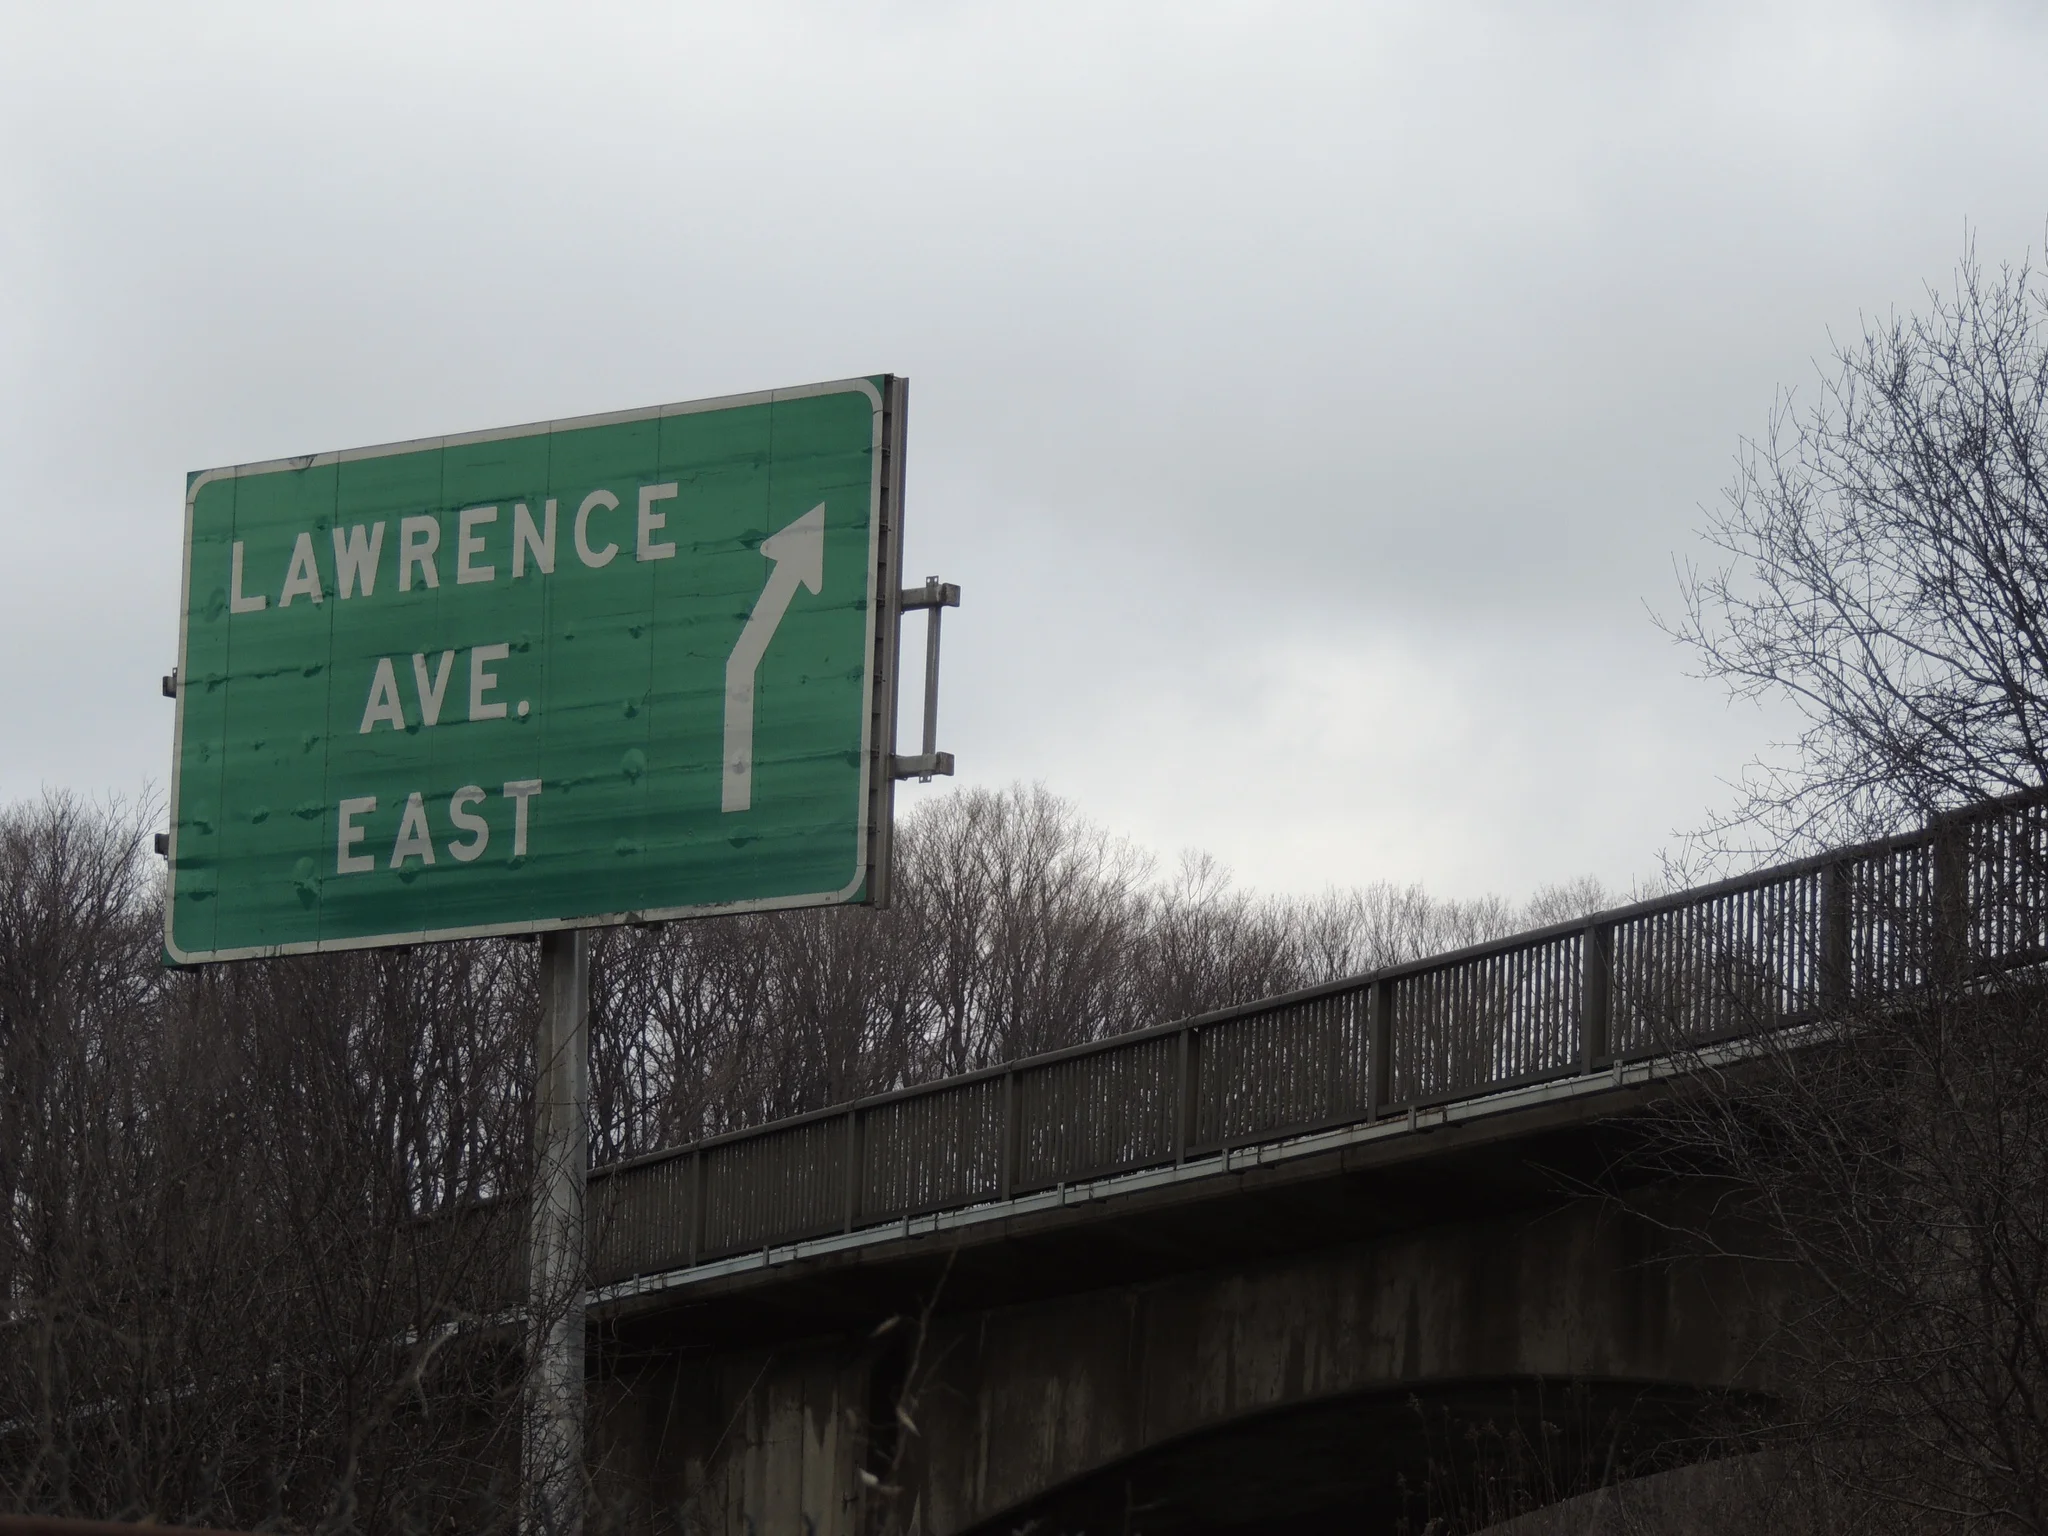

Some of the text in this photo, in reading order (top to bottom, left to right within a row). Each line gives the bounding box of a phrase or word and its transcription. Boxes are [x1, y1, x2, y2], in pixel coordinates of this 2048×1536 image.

[230, 482, 678, 614] LAWRENCE
[359, 643, 530, 734] AVE.
[337, 778, 542, 874] EAST
